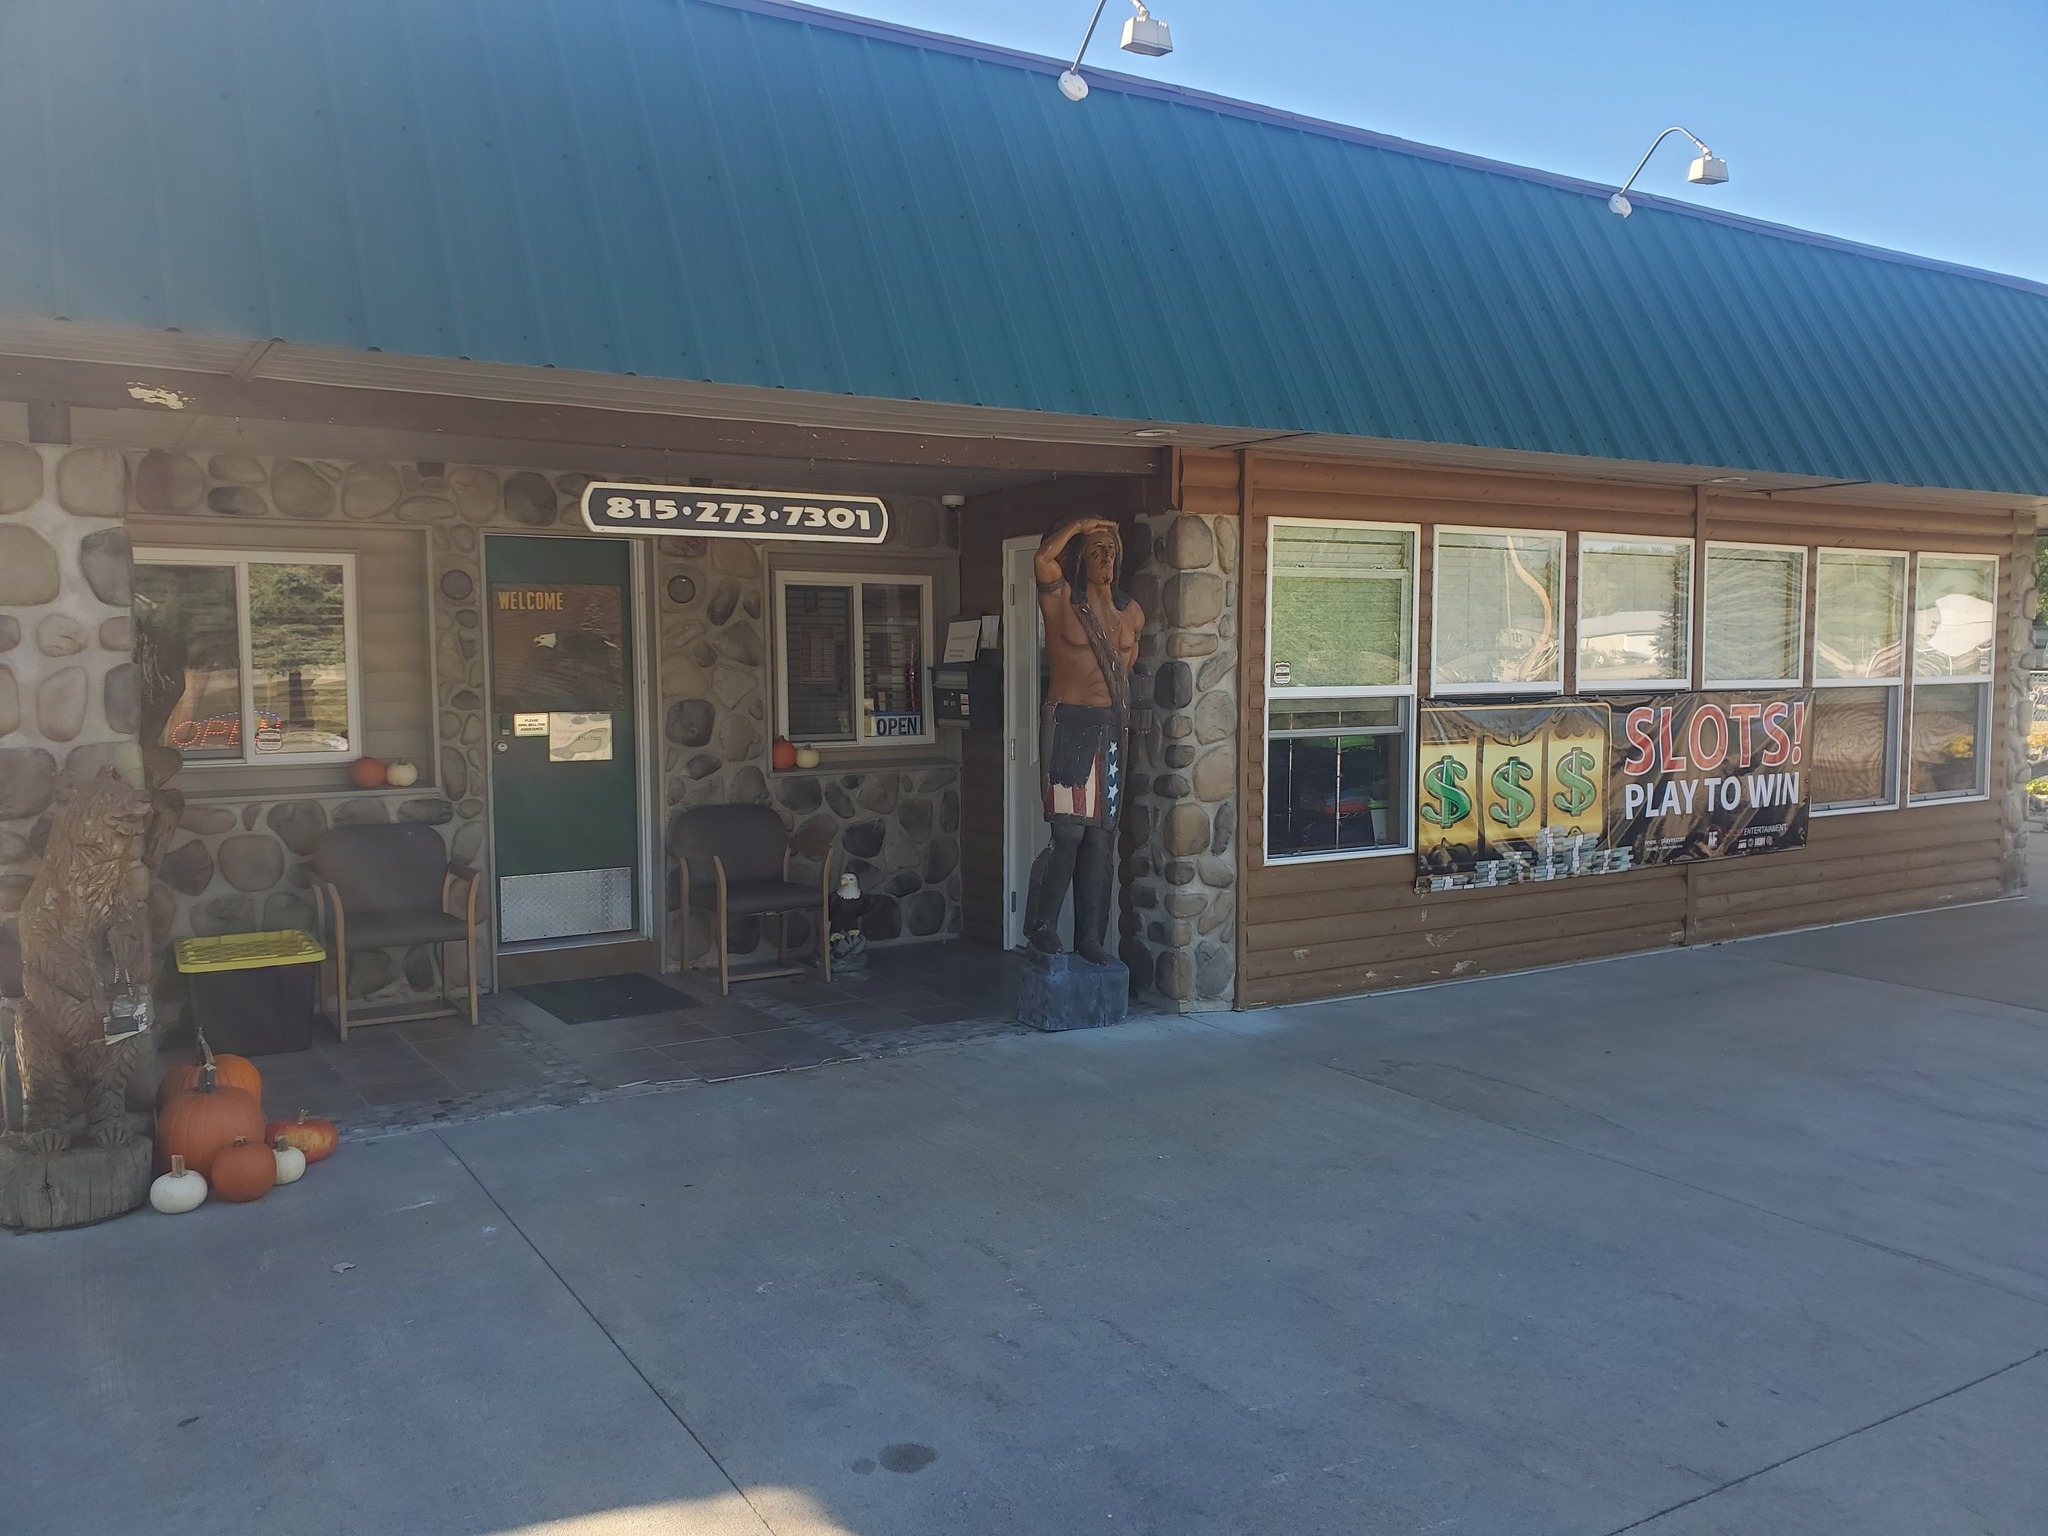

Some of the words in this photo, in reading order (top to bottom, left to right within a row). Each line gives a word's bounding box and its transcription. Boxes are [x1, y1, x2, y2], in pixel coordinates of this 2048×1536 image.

[498, 591, 564, 610] WELCOME
[876, 716, 918, 736] OPEN
[1623, 701, 1805, 775] SLOTS!
[1625, 778, 1700, 820] PLAY
[1704, 775, 1743, 812] TO
[1747, 771, 1800, 808] WIN
